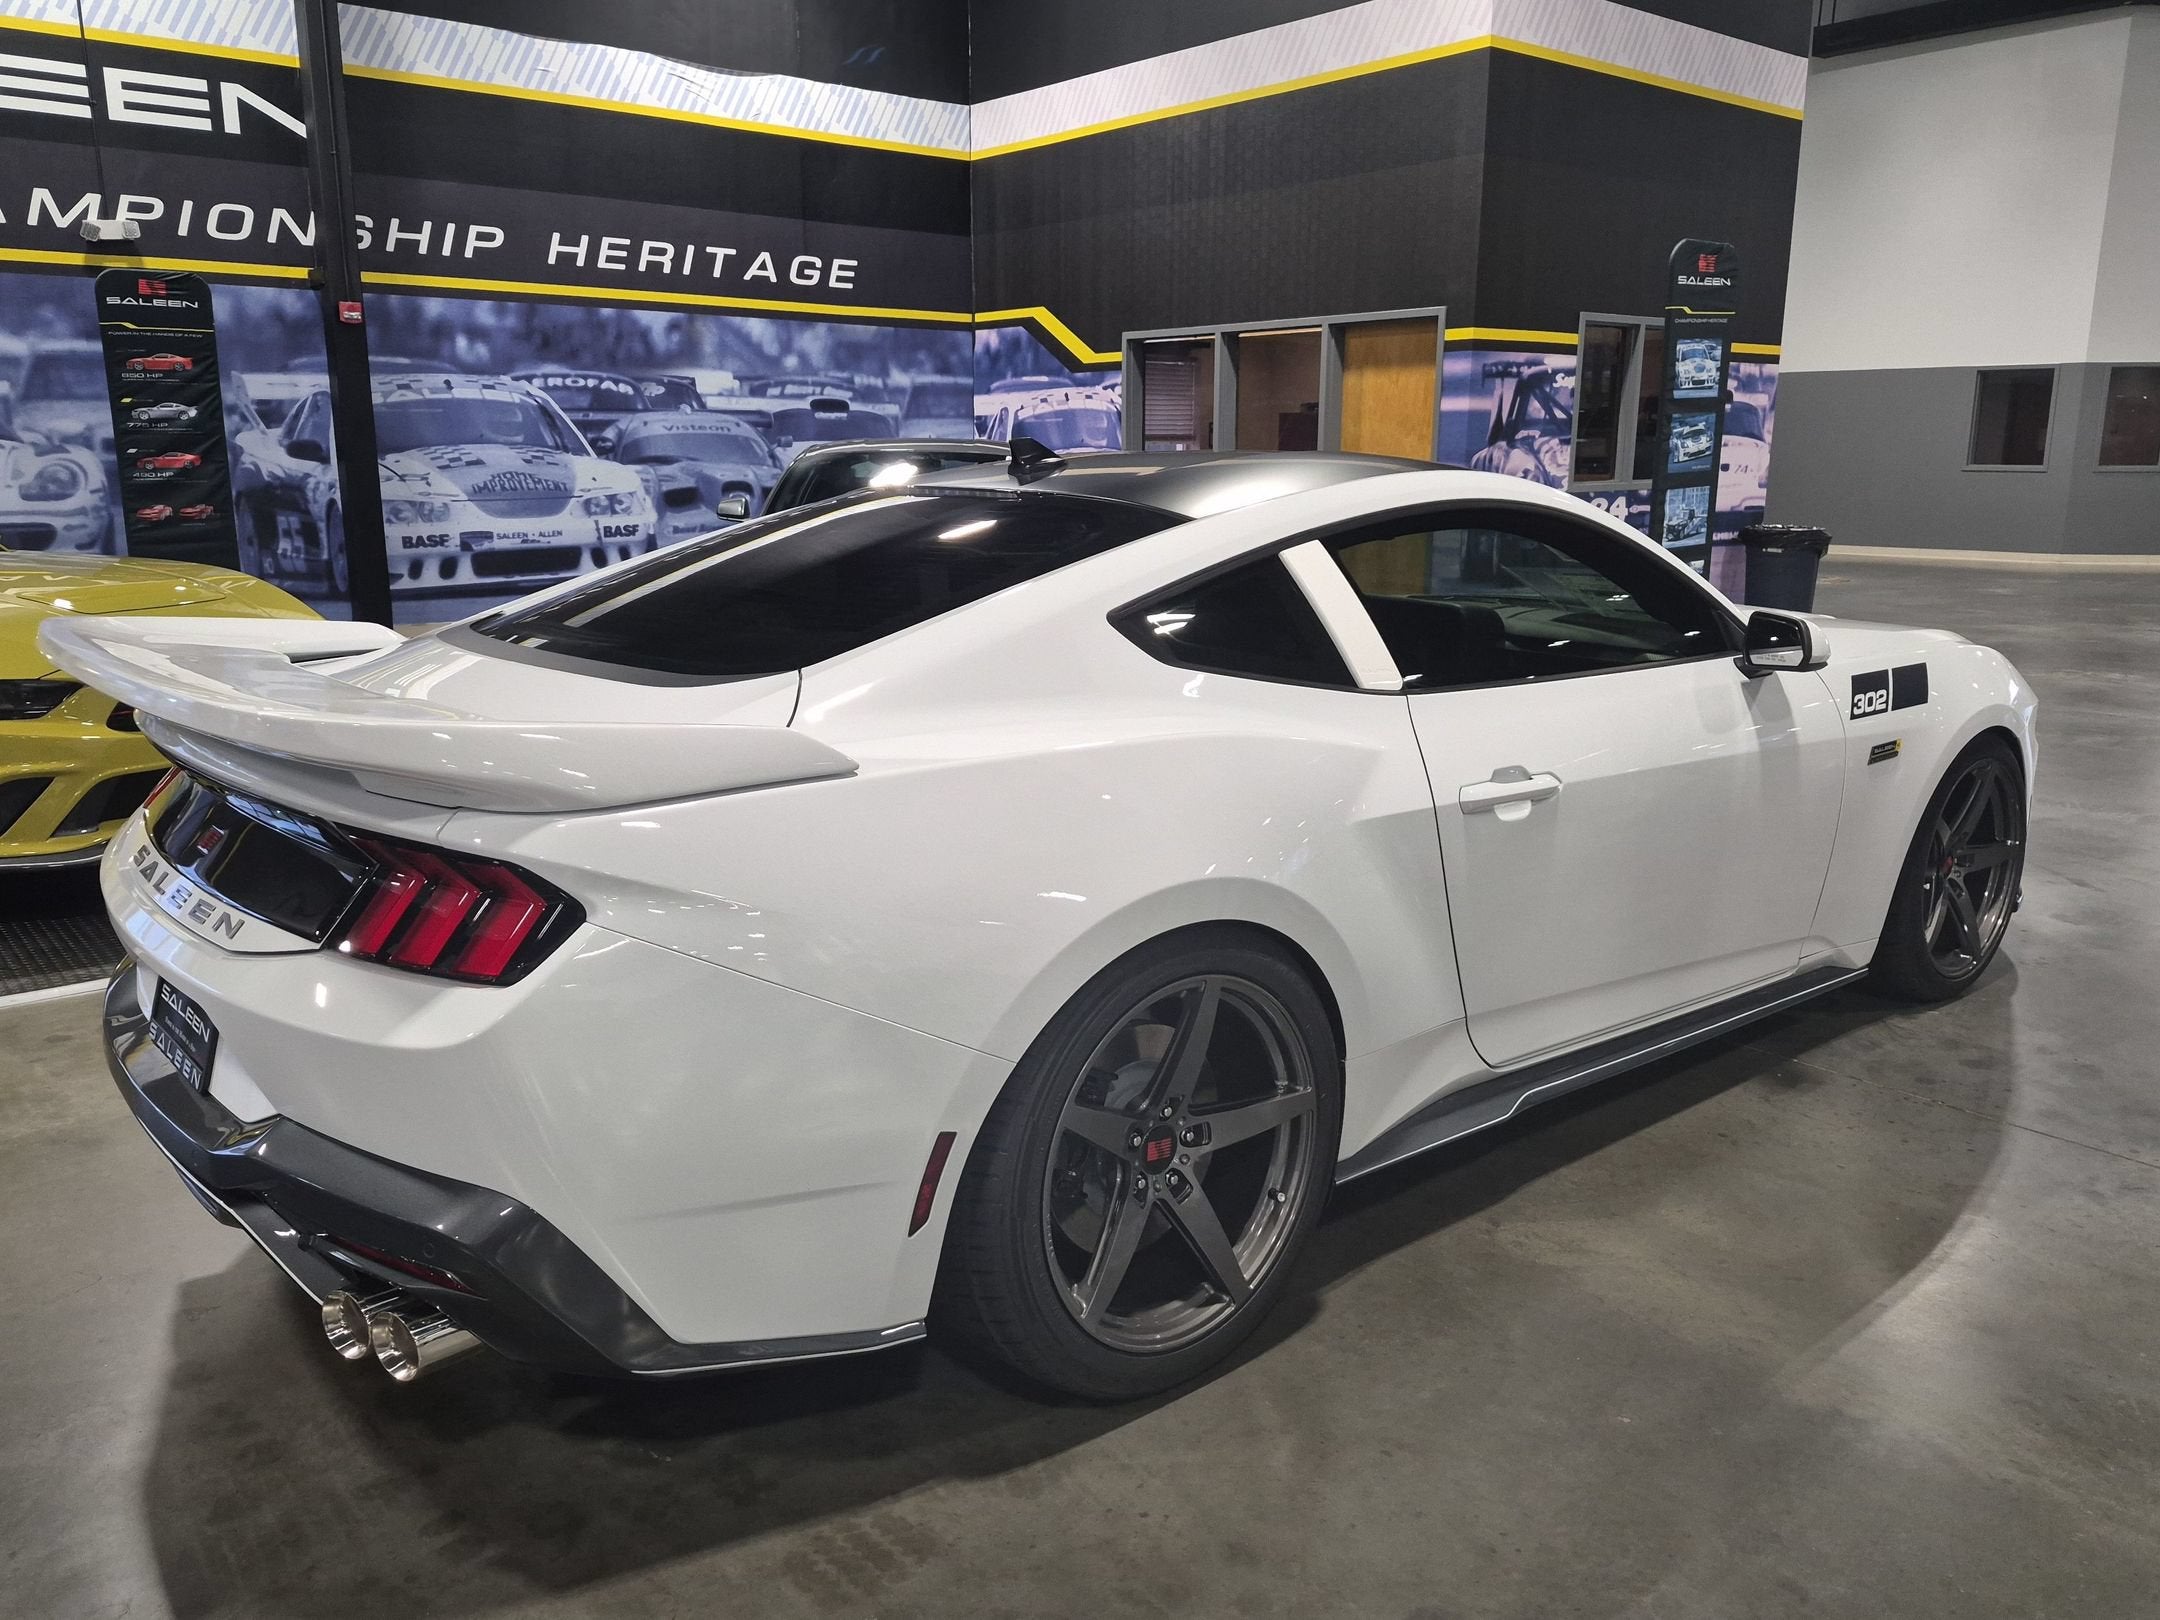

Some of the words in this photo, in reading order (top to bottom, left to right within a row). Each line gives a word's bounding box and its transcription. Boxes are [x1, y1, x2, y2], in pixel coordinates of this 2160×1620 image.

[0, 186, 505, 260] MPIONSHIP
[547, 232, 859, 290] HERITAGE
[1677, 275, 1731, 286] SALEEN
[105, 296, 199, 309] SALEEN
[471, 474, 569, 495] IMPROVEMENT
[402, 534, 451, 550] BASF
[496, 532, 529, 541] SALEEN
[538, 529, 563, 538] ALLEN
[603, 524, 640, 539] BASF
[1853, 689, 1887, 715] 302
[132, 845, 245, 940] SALEEN
[160, 983, 211, 1043] SALEEN
[148, 1021, 202, 1091] SALEEN
